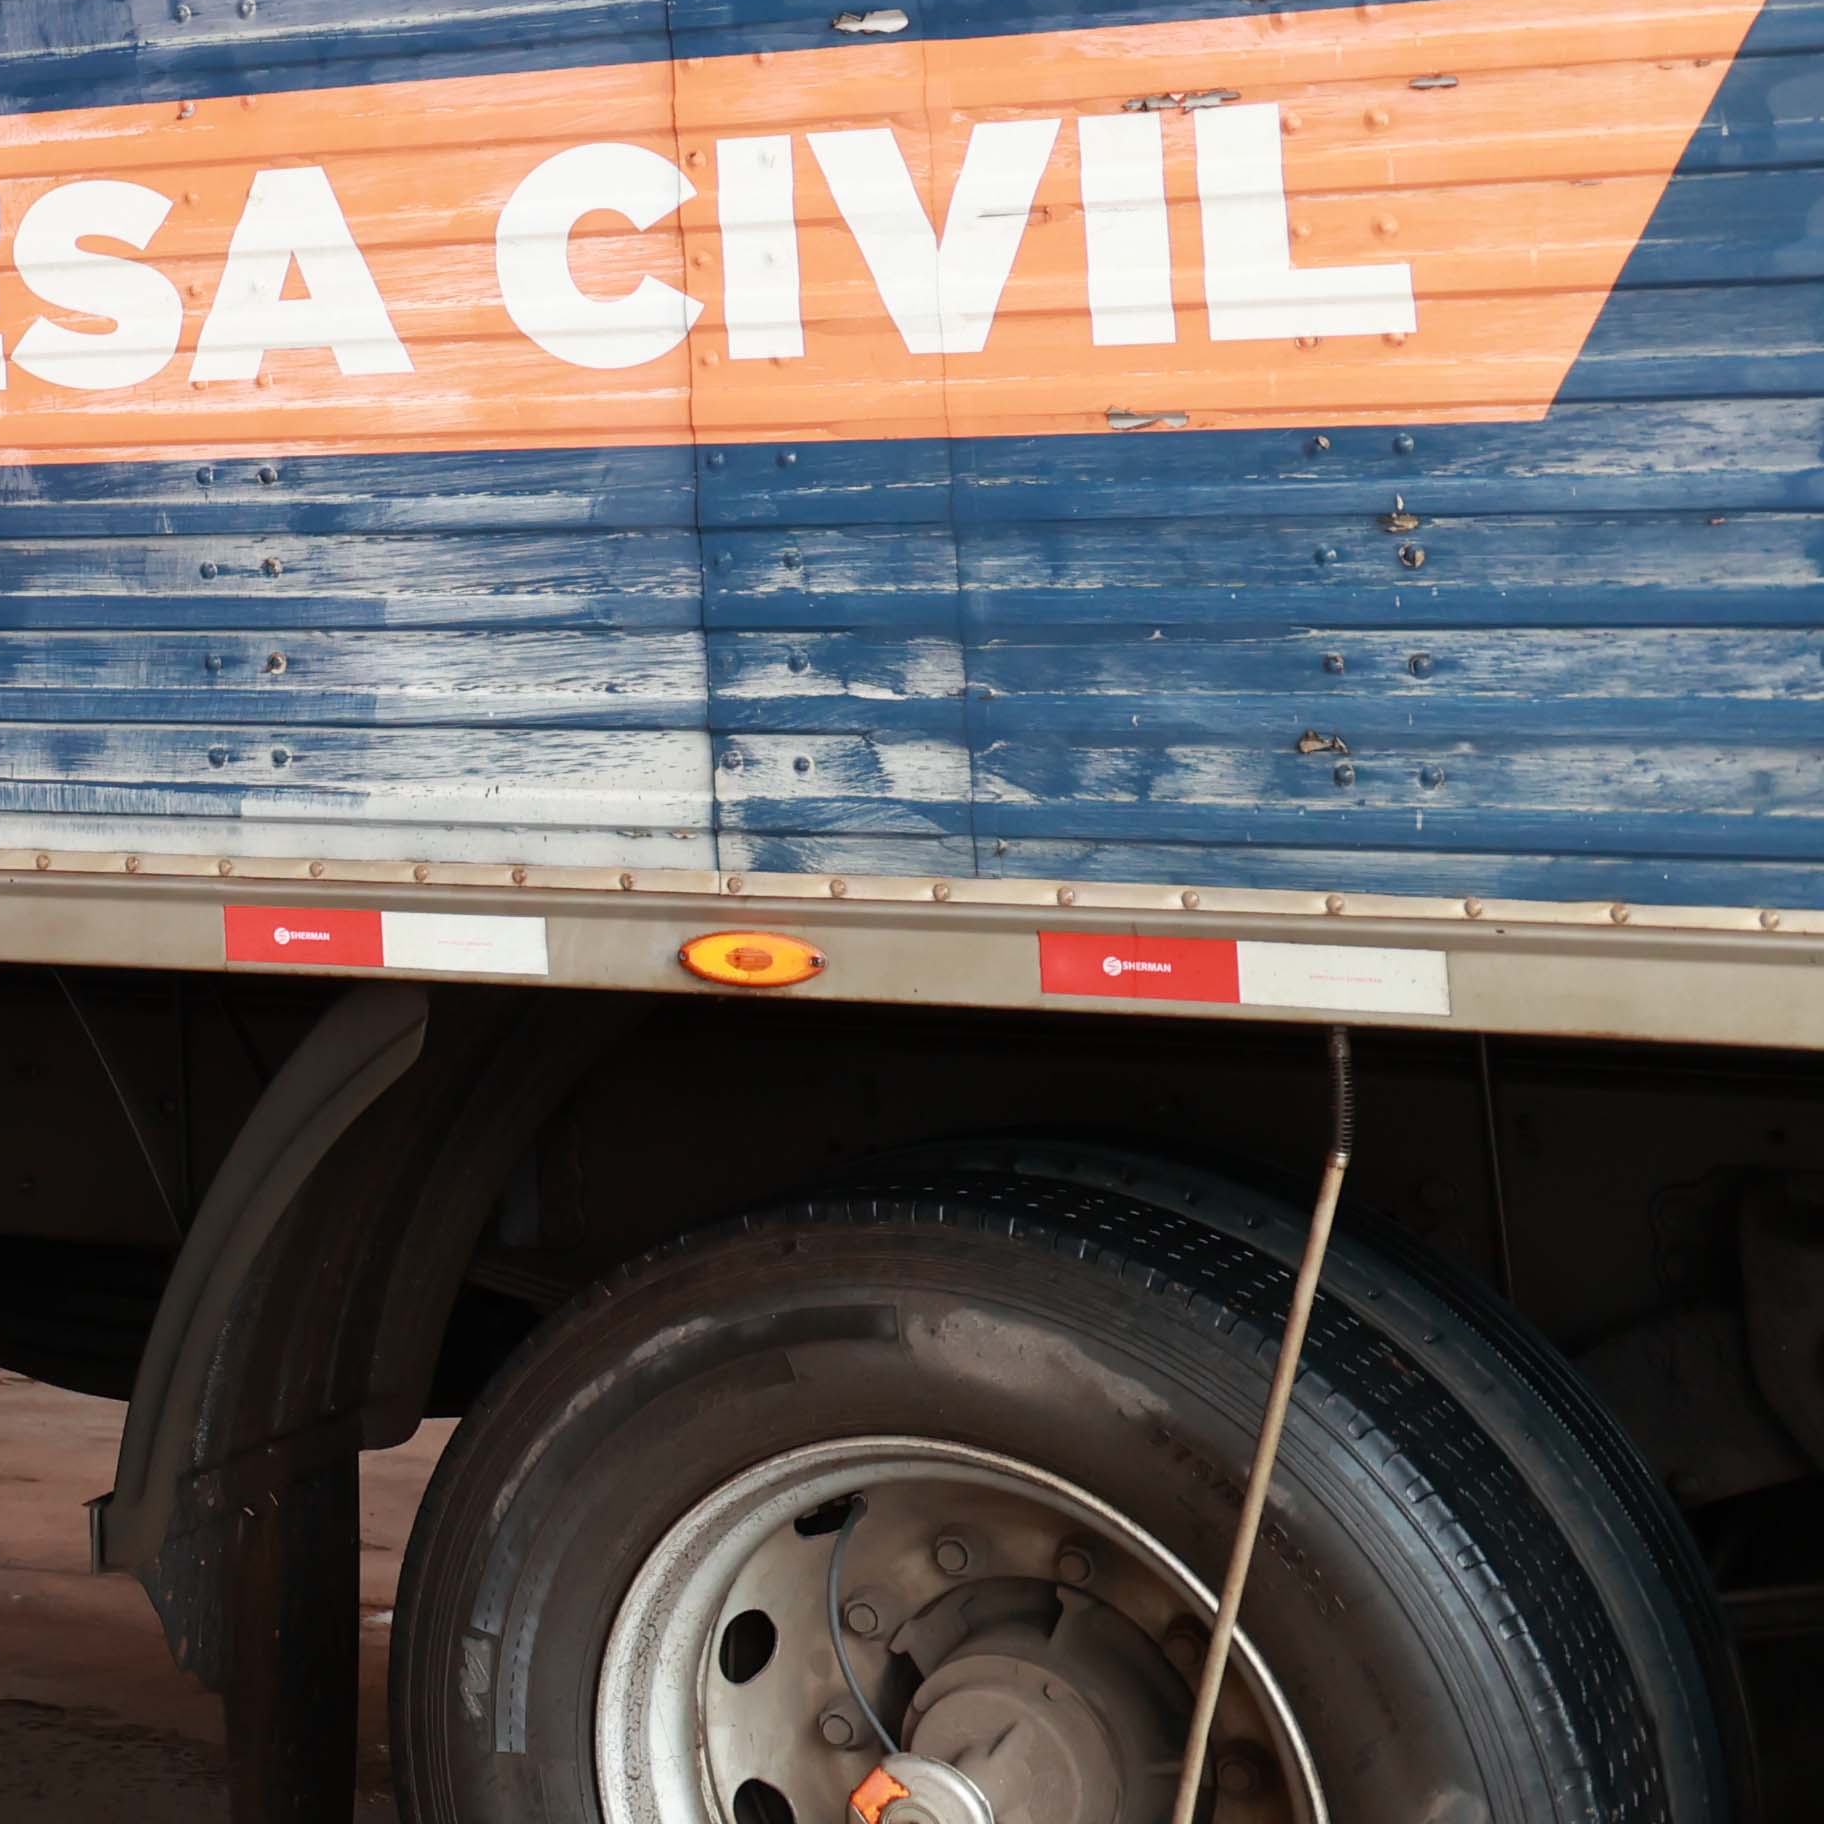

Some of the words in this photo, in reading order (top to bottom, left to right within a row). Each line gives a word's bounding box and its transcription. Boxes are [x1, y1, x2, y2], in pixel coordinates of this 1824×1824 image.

[494, 102, 1418, 370] CIVIL
[290, 931, 331, 941] SHERMAN
[1121, 960, 1172, 974] SHERMAN
